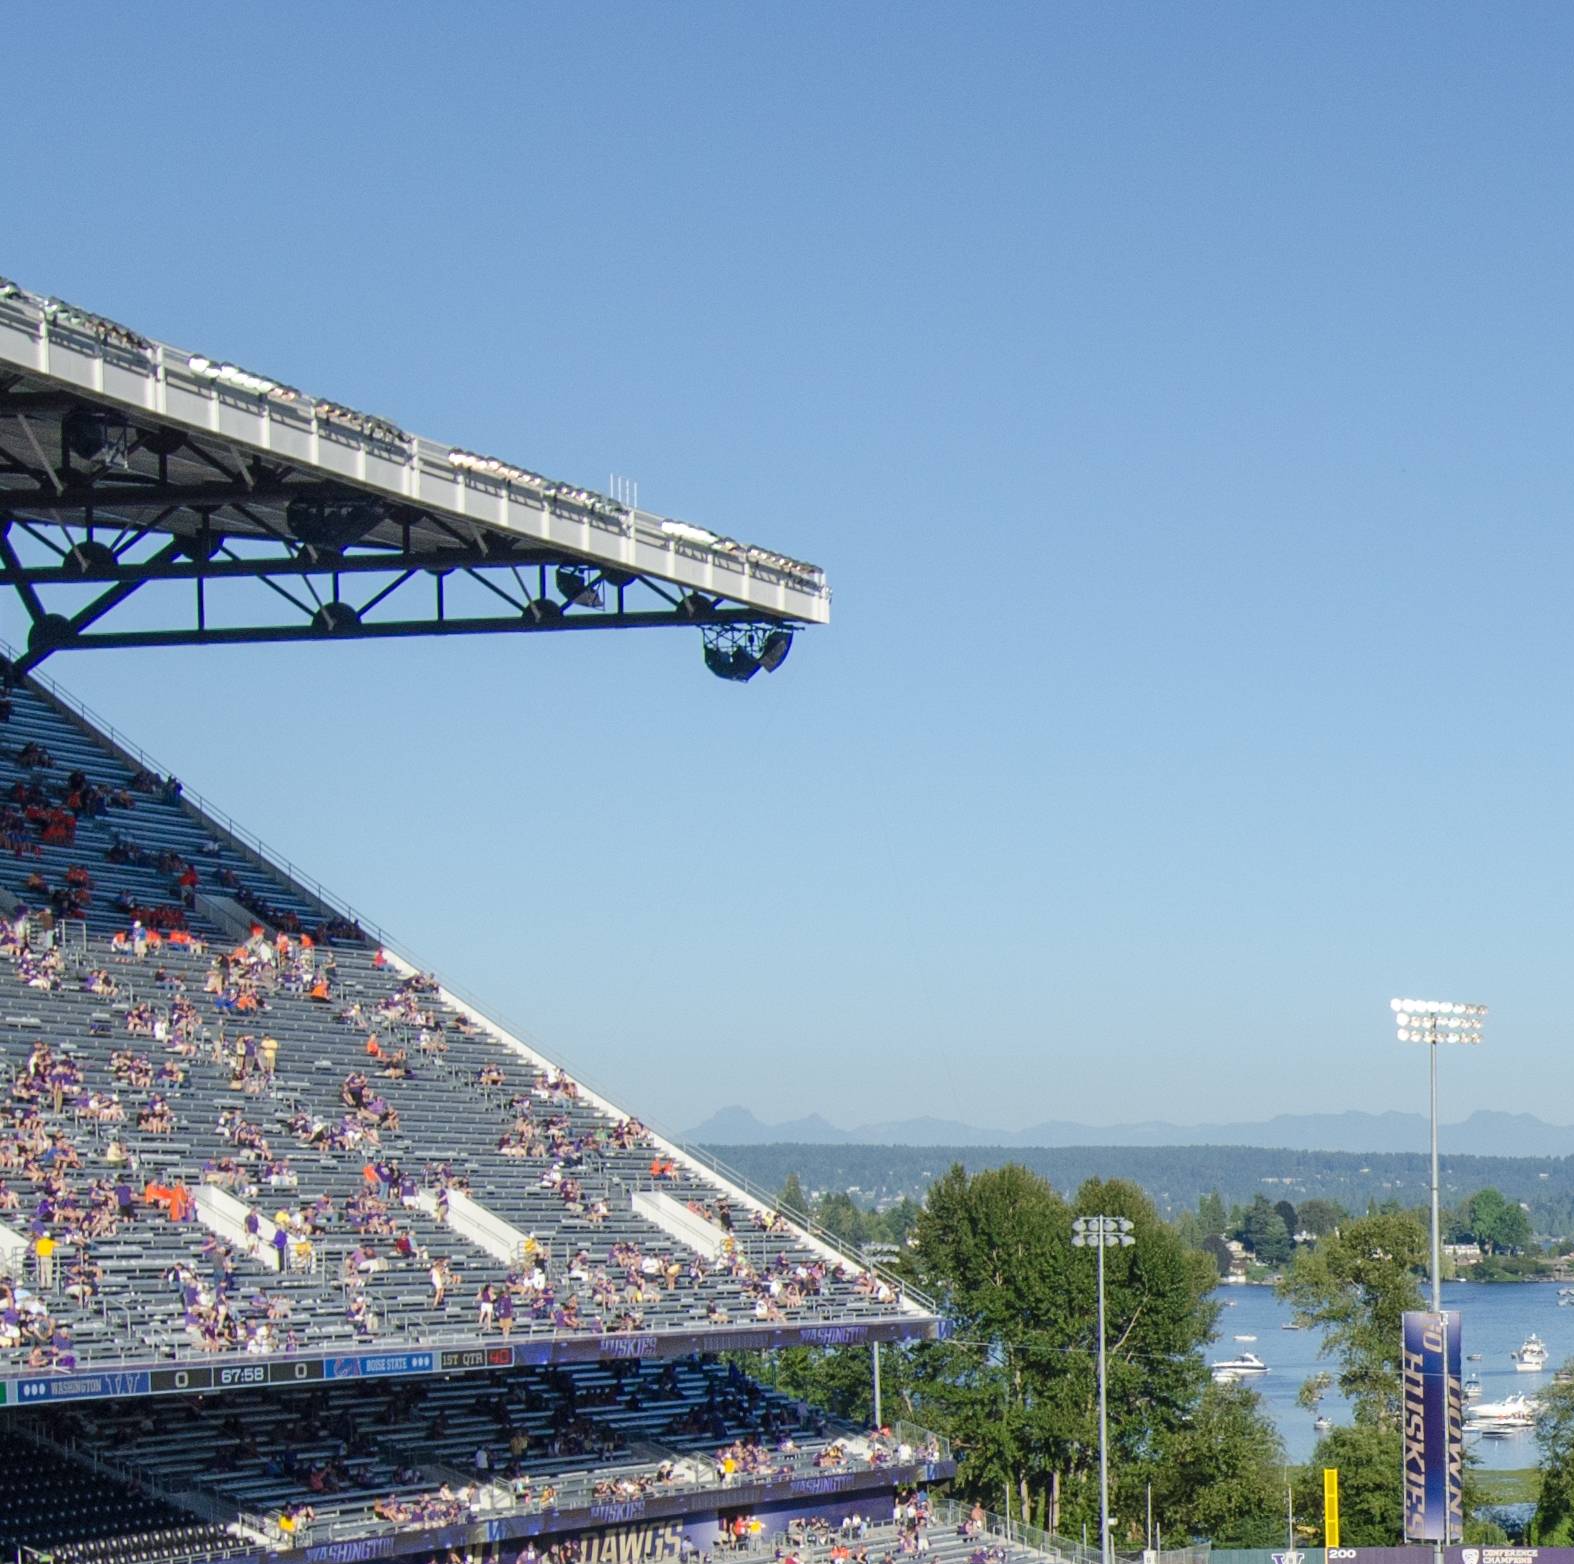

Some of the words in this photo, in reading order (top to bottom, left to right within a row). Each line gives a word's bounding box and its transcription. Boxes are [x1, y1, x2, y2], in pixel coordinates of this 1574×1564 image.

[800, 1326, 868, 1344] WASHINGTON
[600, 1337, 657, 1357] HUSKIES
[366, 1358, 386, 1372] BOISE
[387, 1356, 407, 1371] STATE
[441, 1354, 458, 1367] 1ST
[462, 1352, 483, 1365] QTR
[175, 1371, 189, 1388] 0
[221, 1367, 265, 1385] 67:58
[295, 1363, 307, 1379] 0
[51, 1378, 101, 1395] WASHINGTON
[105, 1371, 141, 1395] W
[1404, 1347, 1426, 1538] HUSKIES
[590, 1500, 646, 1521] HUSKIES
[305, 1537, 396, 1562] WASHINGTON
[1328, 1549, 1356, 1559] 200
